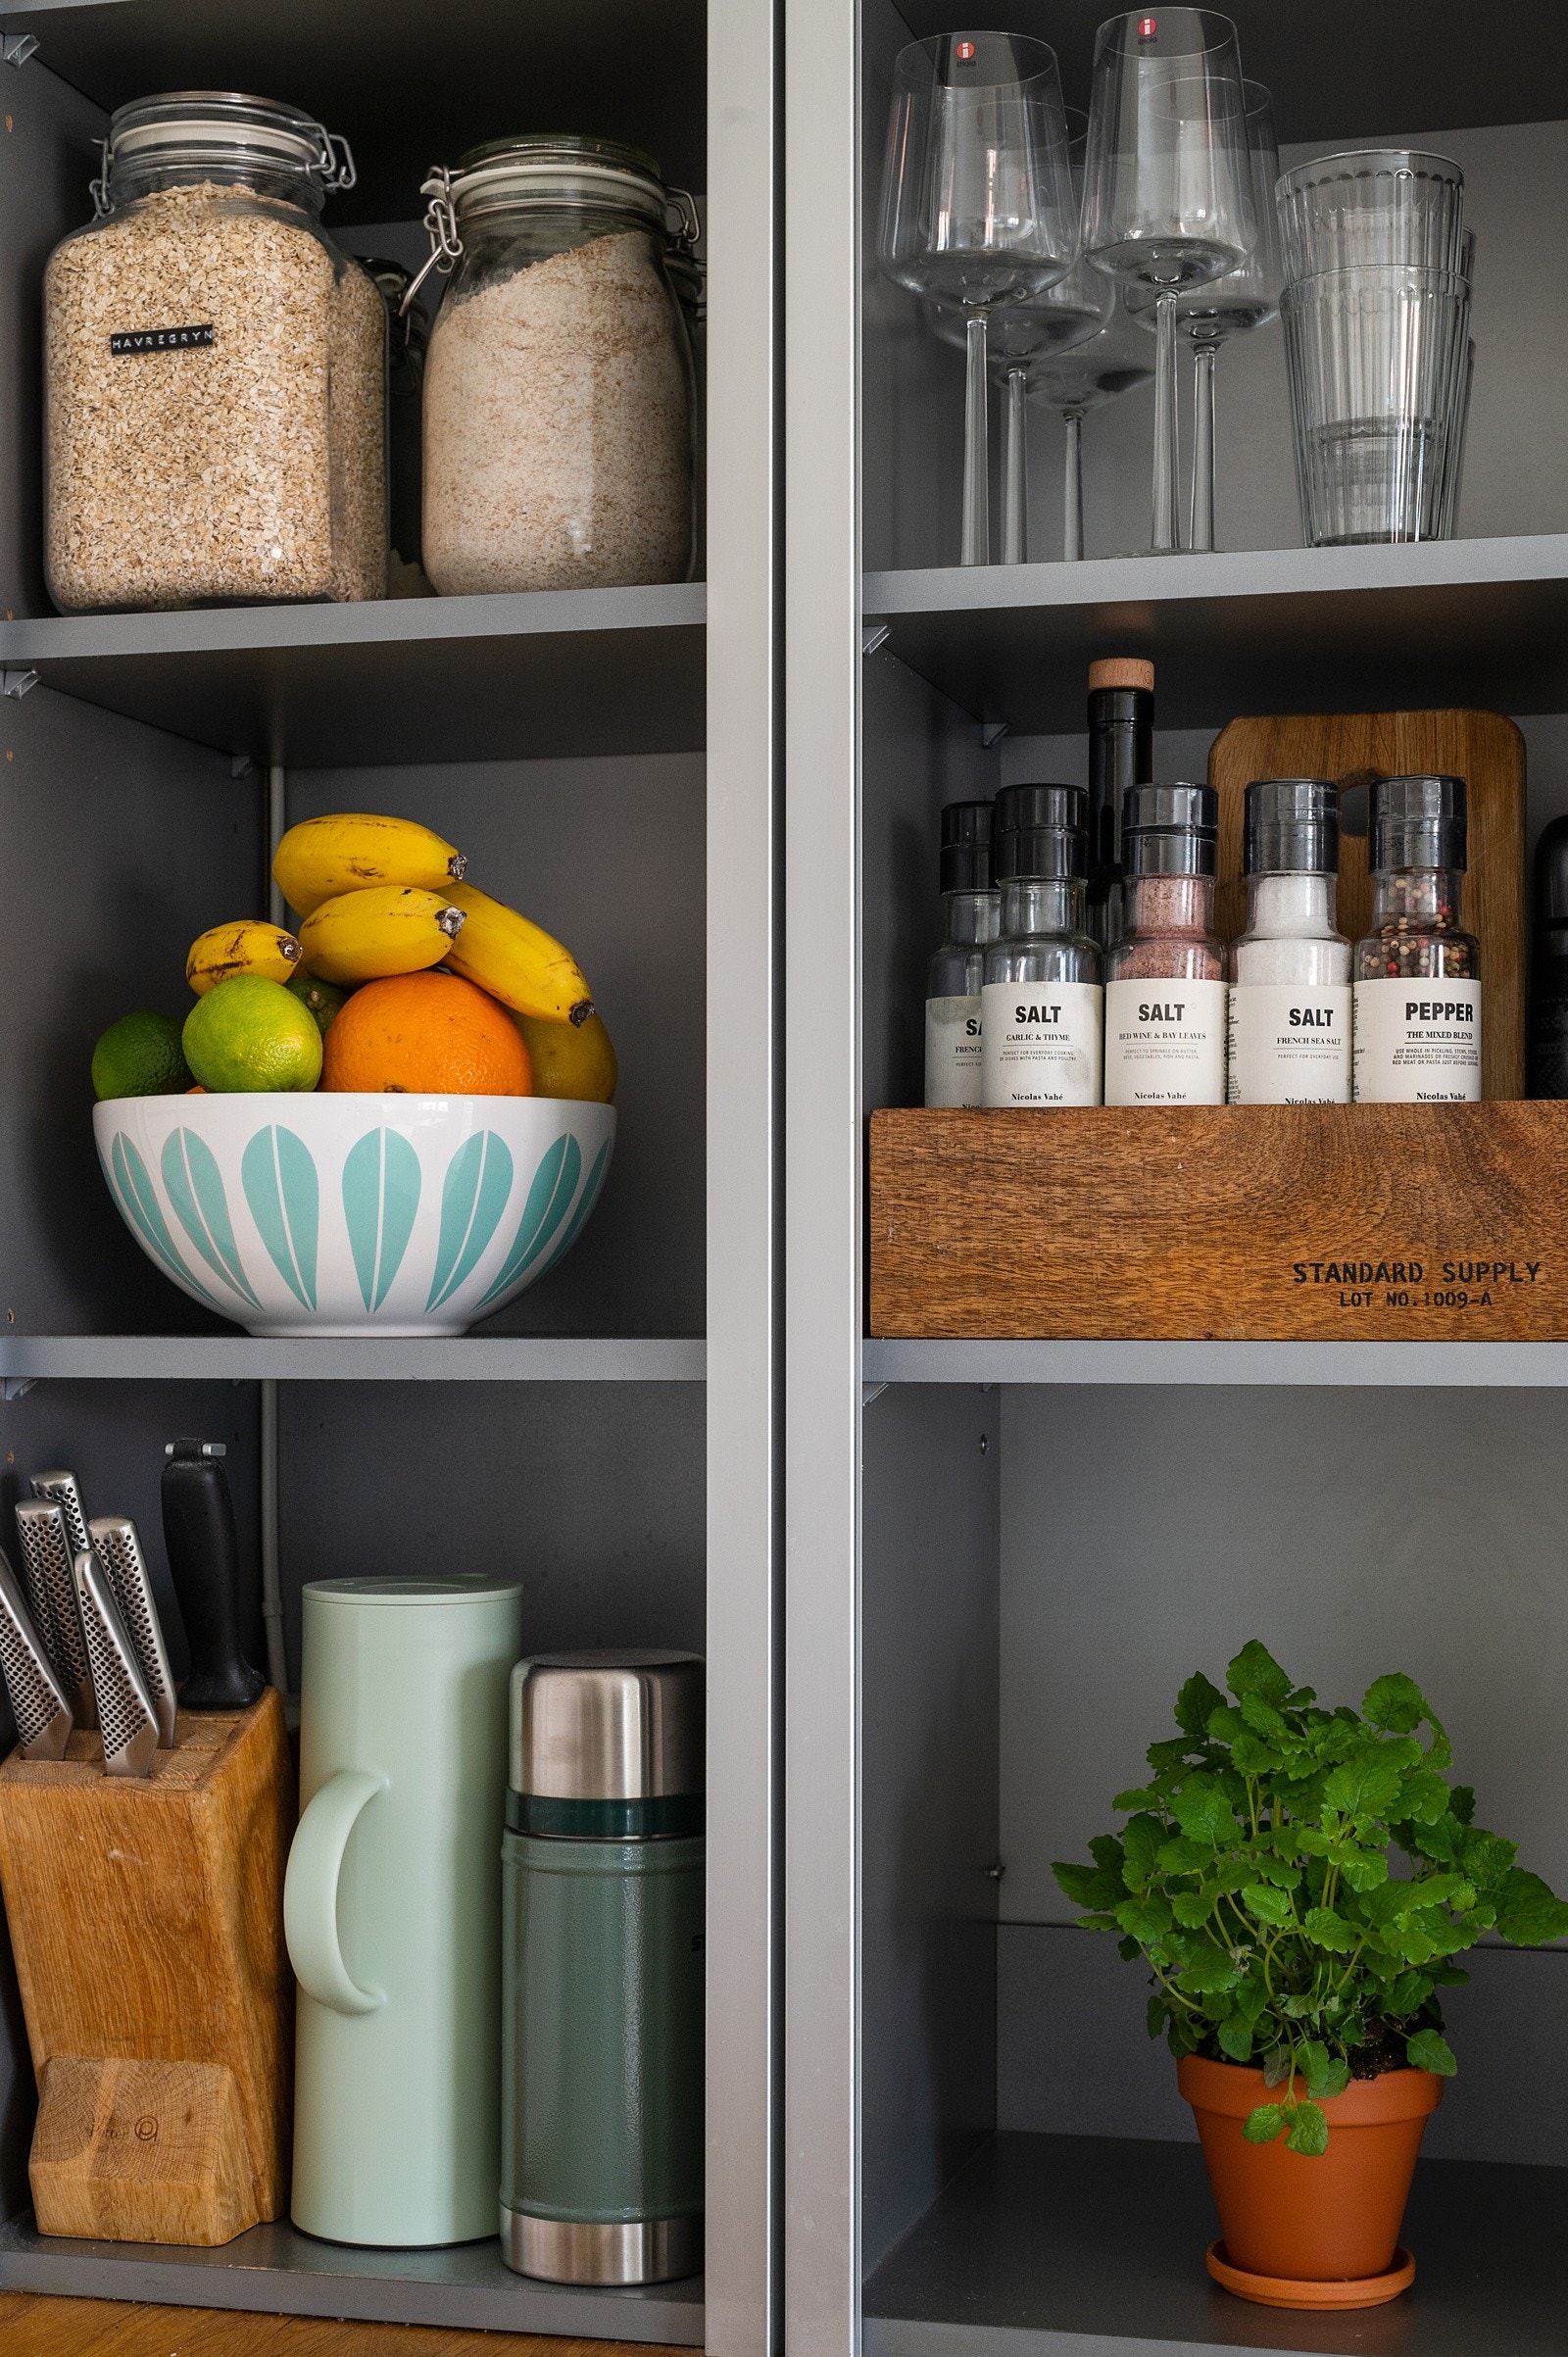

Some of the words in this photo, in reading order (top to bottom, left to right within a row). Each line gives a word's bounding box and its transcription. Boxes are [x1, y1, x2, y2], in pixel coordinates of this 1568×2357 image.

[112, 330, 213, 349] HAVREGRYN
[1015, 1006, 1061, 1023] SALT
[1138, 1004, 1185, 1021] SALT
[1289, 1008, 1334, 1027] SALT
[1405, 1002, 1474, 1022] PEPPER
[1453, 1031, 1473, 1040] BLEND
[1416, 1092, 1447, 1101] Nicolas
[1449, 1092, 1466, 1101] Vahé
[1293, 1261, 1424, 1284] STANDARD
[1443, 1261, 1542, 1284] SUPPLY
[1340, 1291, 1374, 1307] LOT
